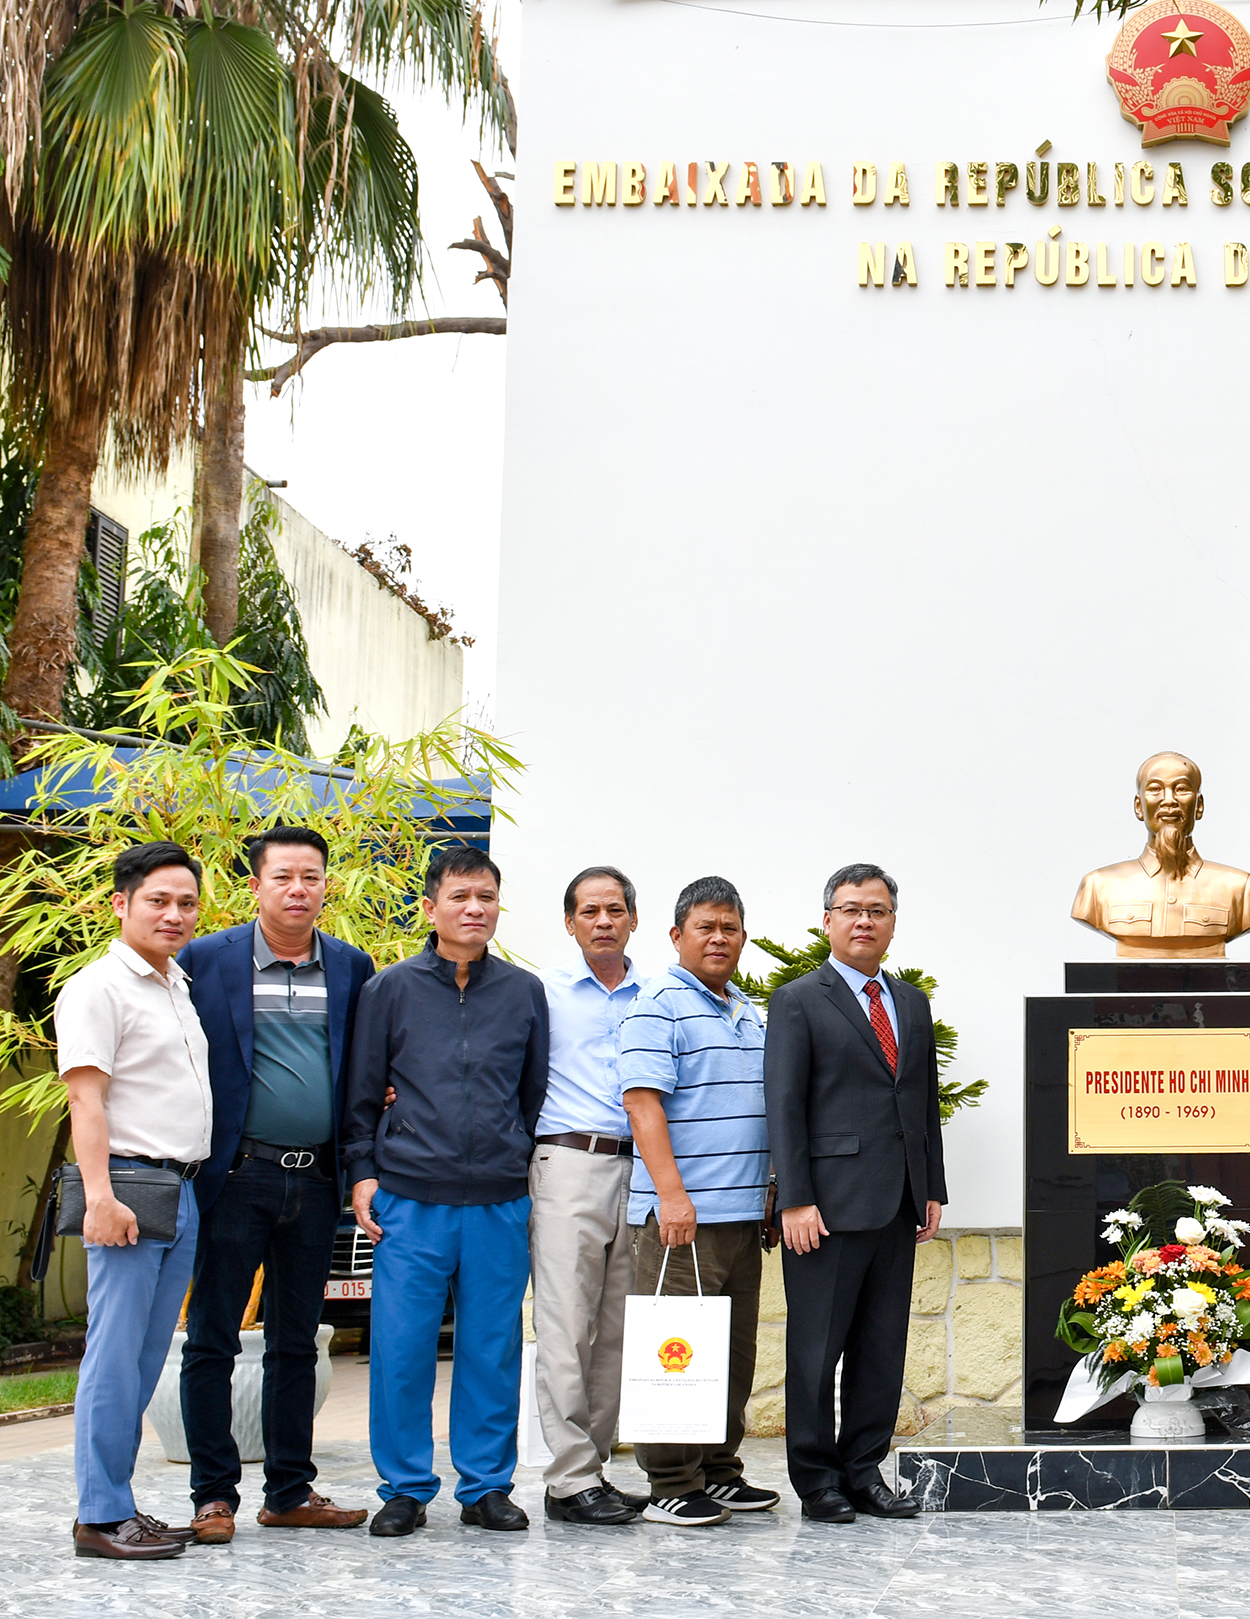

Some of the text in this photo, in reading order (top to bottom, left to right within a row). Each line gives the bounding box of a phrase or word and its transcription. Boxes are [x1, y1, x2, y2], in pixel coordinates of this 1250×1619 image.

[1187, 115, 1205, 124] NAM
[554, 160, 827, 207] EMBAIXADA
[852, 160, 911, 207] DA
[936, 139, 1189, 207] REPÚBLICA
[858, 241, 917, 287] NA
[945, 225, 1197, 288] REPÚBLICA
[1086, 1070, 1249, 1094] PRESIDENTE HO CHI MINH
[1120, 1106, 1160, 1119] (1890
[1176, 1105, 1216, 1119] 1969)
[280, 1151, 315, 1168] CD
